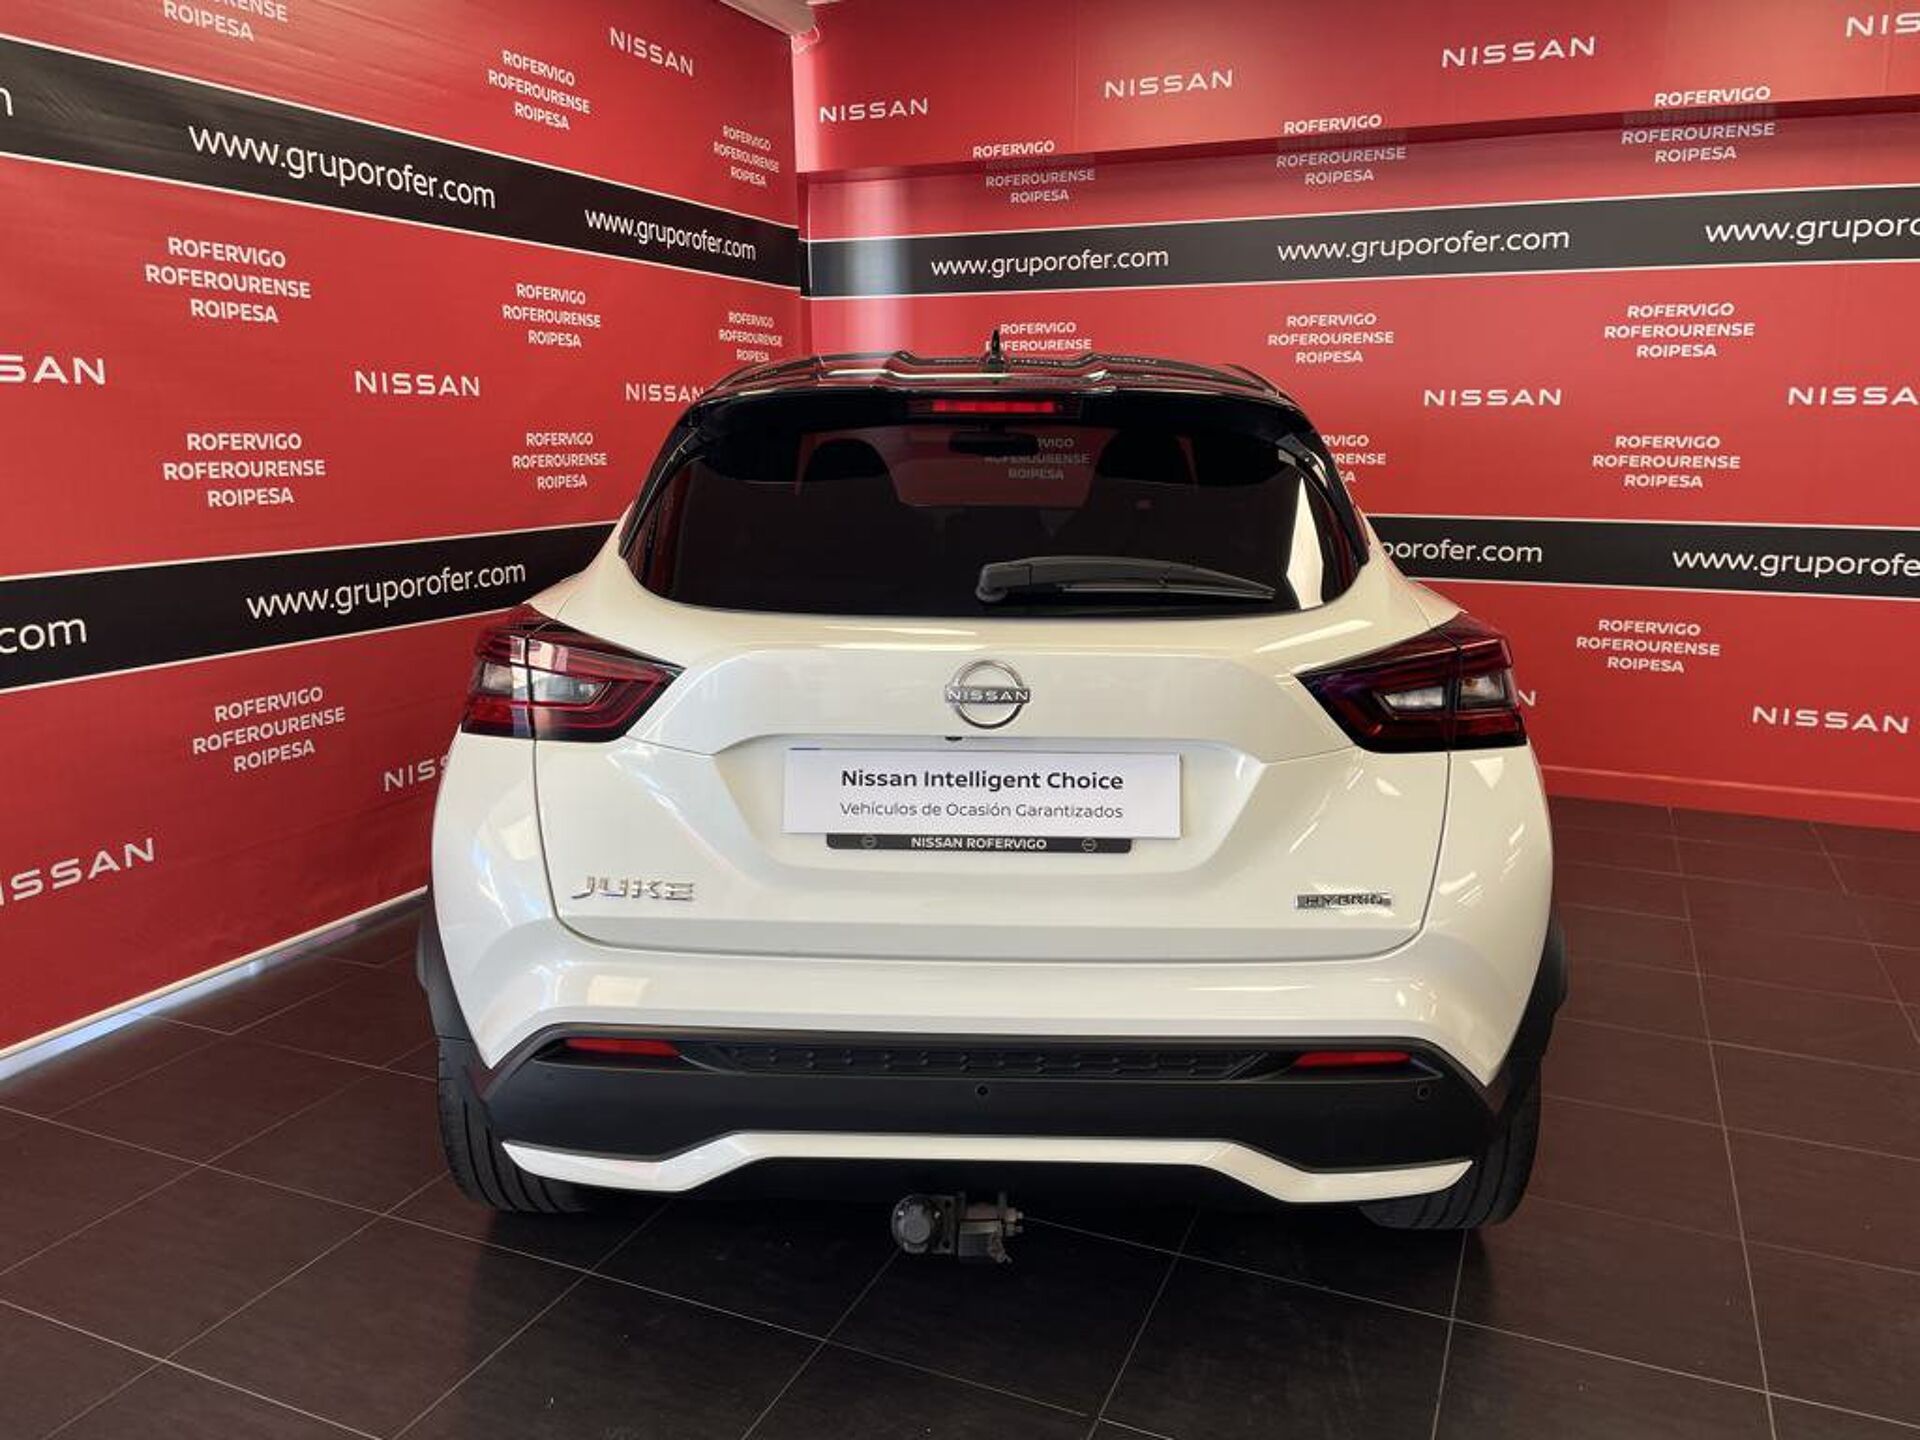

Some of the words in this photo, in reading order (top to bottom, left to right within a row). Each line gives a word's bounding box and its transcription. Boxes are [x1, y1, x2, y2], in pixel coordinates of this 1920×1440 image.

[164, 1, 255, 42] ROIPESA
[609, 26, 693, 77] NISSAN
[1441, 36, 1595, 68] NISSAN
[502, 49, 575, 87] ROFERVIGO
[488, 69, 591, 114] ROFEROURENSE
[1105, 69, 1233, 98] NISSAN
[1654, 85, 1771, 108] ROFERVIGO
[514, 102, 570, 130] ROIPESA
[819, 97, 929, 123] NISSAN
[1283, 113, 1383, 135] ROFERVIGO
[1621, 122, 1776, 145] ROFEROURENSE
[722, 125, 772, 151] ROFERVIGO
[972, 139, 1056, 159] ROFERVIGO
[1276, 146, 1407, 169] ROFEROURENSE
[1654, 145, 1737, 164] ROIPESA
[188, 125, 496, 209] www.gruporofer.com
[730, 166, 767, 187] ROIPESA
[985, 168, 1096, 188] ROFEROURENSE
[1304, 168, 1374, 185] ROIPESA
[1010, 189, 1070, 204] ROIPESA
[584, 208, 756, 260] www.gruporofer.com
[168, 237, 286, 269] ROFERVIGO
[1277, 229, 1570, 264] www.gruporofer.com
[930, 248, 1169, 279] www.gruporofer.com
[145, 264, 311, 299] ROFEROURENSE
[516, 283, 586, 305] ROFERVIGO
[190, 299, 278, 324] ROIPESA
[502, 304, 601, 329] ROFEROURENSE
[1286, 312, 1377, 327] ROFERVIGO
[1626, 302, 1735, 319] ROFERVIGO
[528, 329, 582, 348] ROIPESA
[999, 320, 1078, 335] ROFERVIGO
[1268, 331, 1394, 346] ROFEROURENSE
[1604, 322, 1756, 339] ROFEROURENSE
[1295, 350, 1364, 364] ROIPESA
[1636, 343, 1717, 358] ROIPESA
[354, 370, 480, 397] NISSAN
[1424, 388, 1562, 406] NISSAN
[186, 432, 302, 451] ROFERVIGO
[526, 432, 594, 447] ROFERVIGO
[1615, 435, 1721, 449] ROFERVIGO
[163, 459, 326, 481] ROFEROURENSE
[511, 452, 607, 469] ROFEROURENSE
[1592, 454, 1741, 469] ROFEROURENSE
[536, 473, 588, 490] ROIPESA
[1624, 474, 1703, 488] ROIPESA
[207, 487, 295, 508] ROIPESA
[246, 563, 526, 620] www.gruporofer.com
[1598, 619, 1702, 637] ROFERVIGO
[1576, 636, 1721, 657] ROFEROURENSE
[1607, 656, 1685, 673] ROIPESA
[213, 687, 323, 723] ROFERVIGO
[948, 689, 1029, 702] NISSAN
[192, 707, 346, 755] ROFEROURENSE
[1752, 706, 1909, 734] NISSAN
[233, 740, 315, 773] ROIPESA
[841, 769, 918, 789] Nissan
[923, 770, 1042, 792] Intelligent
[1046, 771, 1125, 791] Choice
[839, 800, 918, 818] Vehículos
[922, 802, 942, 818] de
[945, 801, 1012, 819] Ocasión
[1014, 802, 1124, 820] Garantizados
[909, 836, 963, 850] NISSAN
[966, 837, 1048, 852] ROFERVIGO
[571, 876, 695, 901] JUKE
